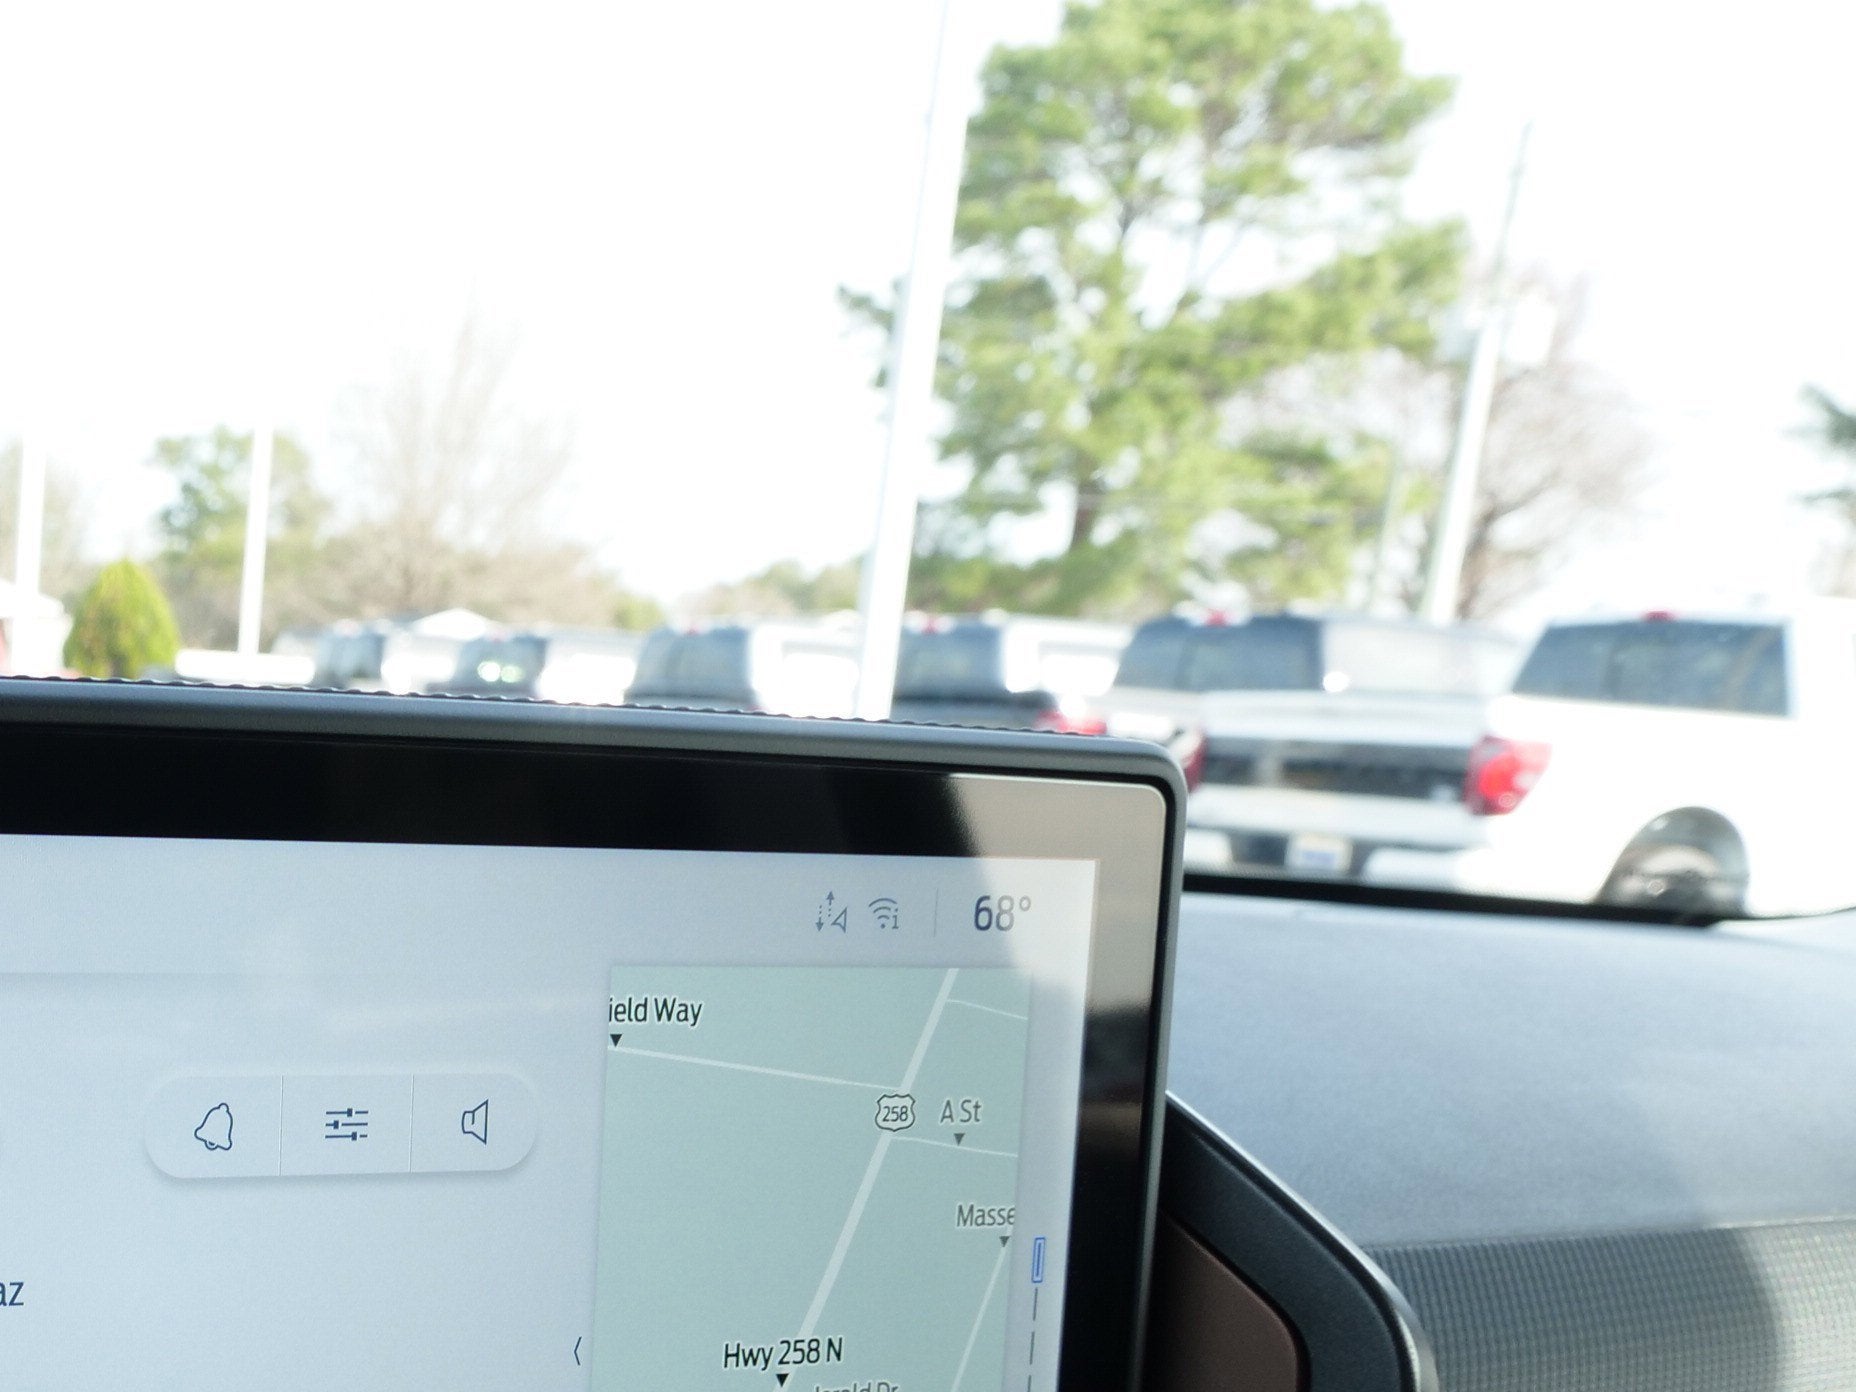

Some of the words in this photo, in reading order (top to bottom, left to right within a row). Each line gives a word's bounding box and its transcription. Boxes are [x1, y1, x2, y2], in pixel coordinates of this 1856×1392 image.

[973, 894, 1033, 933] 68°
[608, 997, 648, 1023] ield
[654, 997, 703, 1027] Way
[882, 1105, 909, 1123] 258
[940, 1099, 955, 1123] A
[960, 1099, 982, 1123] St
[723, 1342, 774, 1371] Hwy
[777, 1338, 821, 1365] 258
[826, 1337, 843, 1363] N
